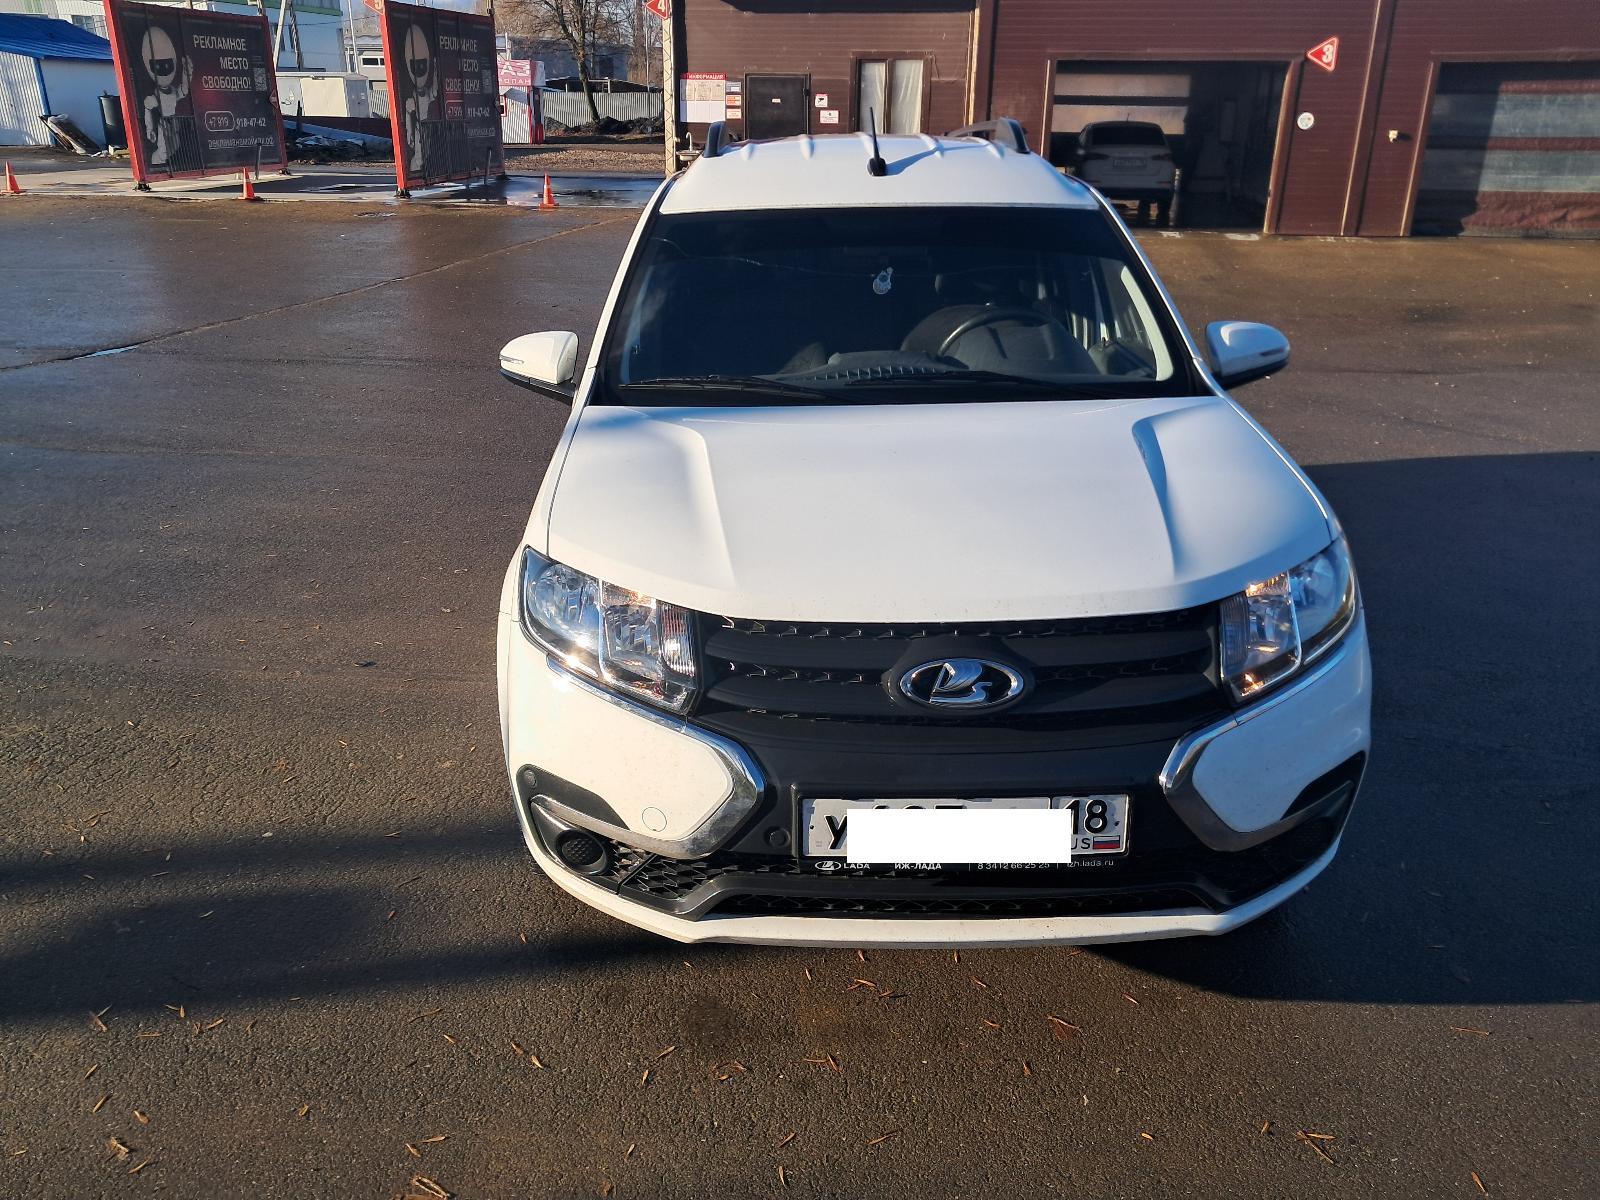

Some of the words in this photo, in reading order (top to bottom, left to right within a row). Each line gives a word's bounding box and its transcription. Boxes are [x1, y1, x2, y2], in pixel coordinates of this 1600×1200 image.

[657, 0, 666, 13] 4
[193, 34, 247, 51] РЕКЛАМНОЕ
[1321, 44, 1334, 64] 3
[219, 56, 249, 70] МЕСТО
[500, 61, 530, 77] АЗ
[202, 75, 252, 92] СВОБОДНО!
[1063, 799, 1108, 835] 18
[1070, 837, 1091, 850] US
[843, 862, 871, 870] LADA
[894, 862, 942, 871] ИЖ-ЛАДА
